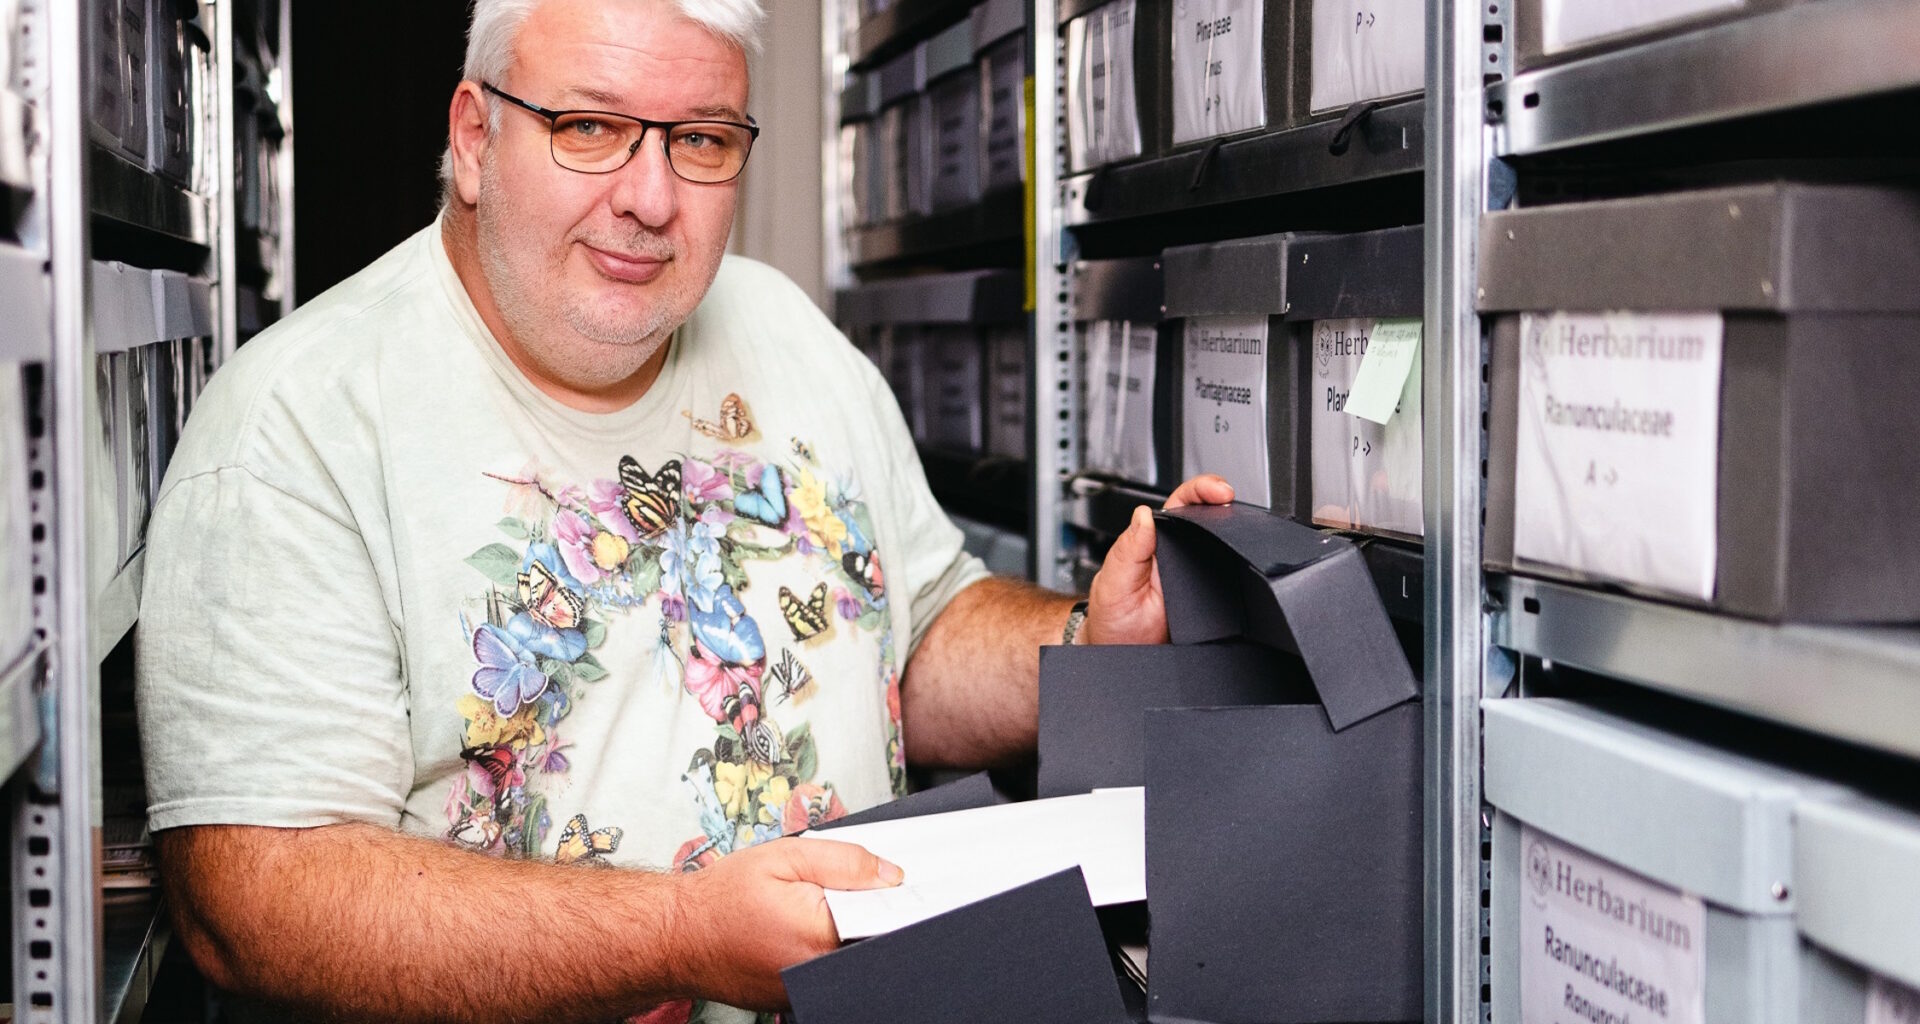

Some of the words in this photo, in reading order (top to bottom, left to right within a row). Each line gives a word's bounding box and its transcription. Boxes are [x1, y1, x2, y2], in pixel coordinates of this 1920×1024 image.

[1200, 329, 1262, 356] Herbarium
[1335, 329, 1368, 356] Herb
[1556, 323, 1704, 361] Herbarium
[1195, 376, 1251, 407] Plantaginaceae
[1544, 396, 1674, 436] Ranunculaceae
[1555, 859, 1691, 952] Herbarium
[1545, 924, 1668, 1018] Ranunculaceae
